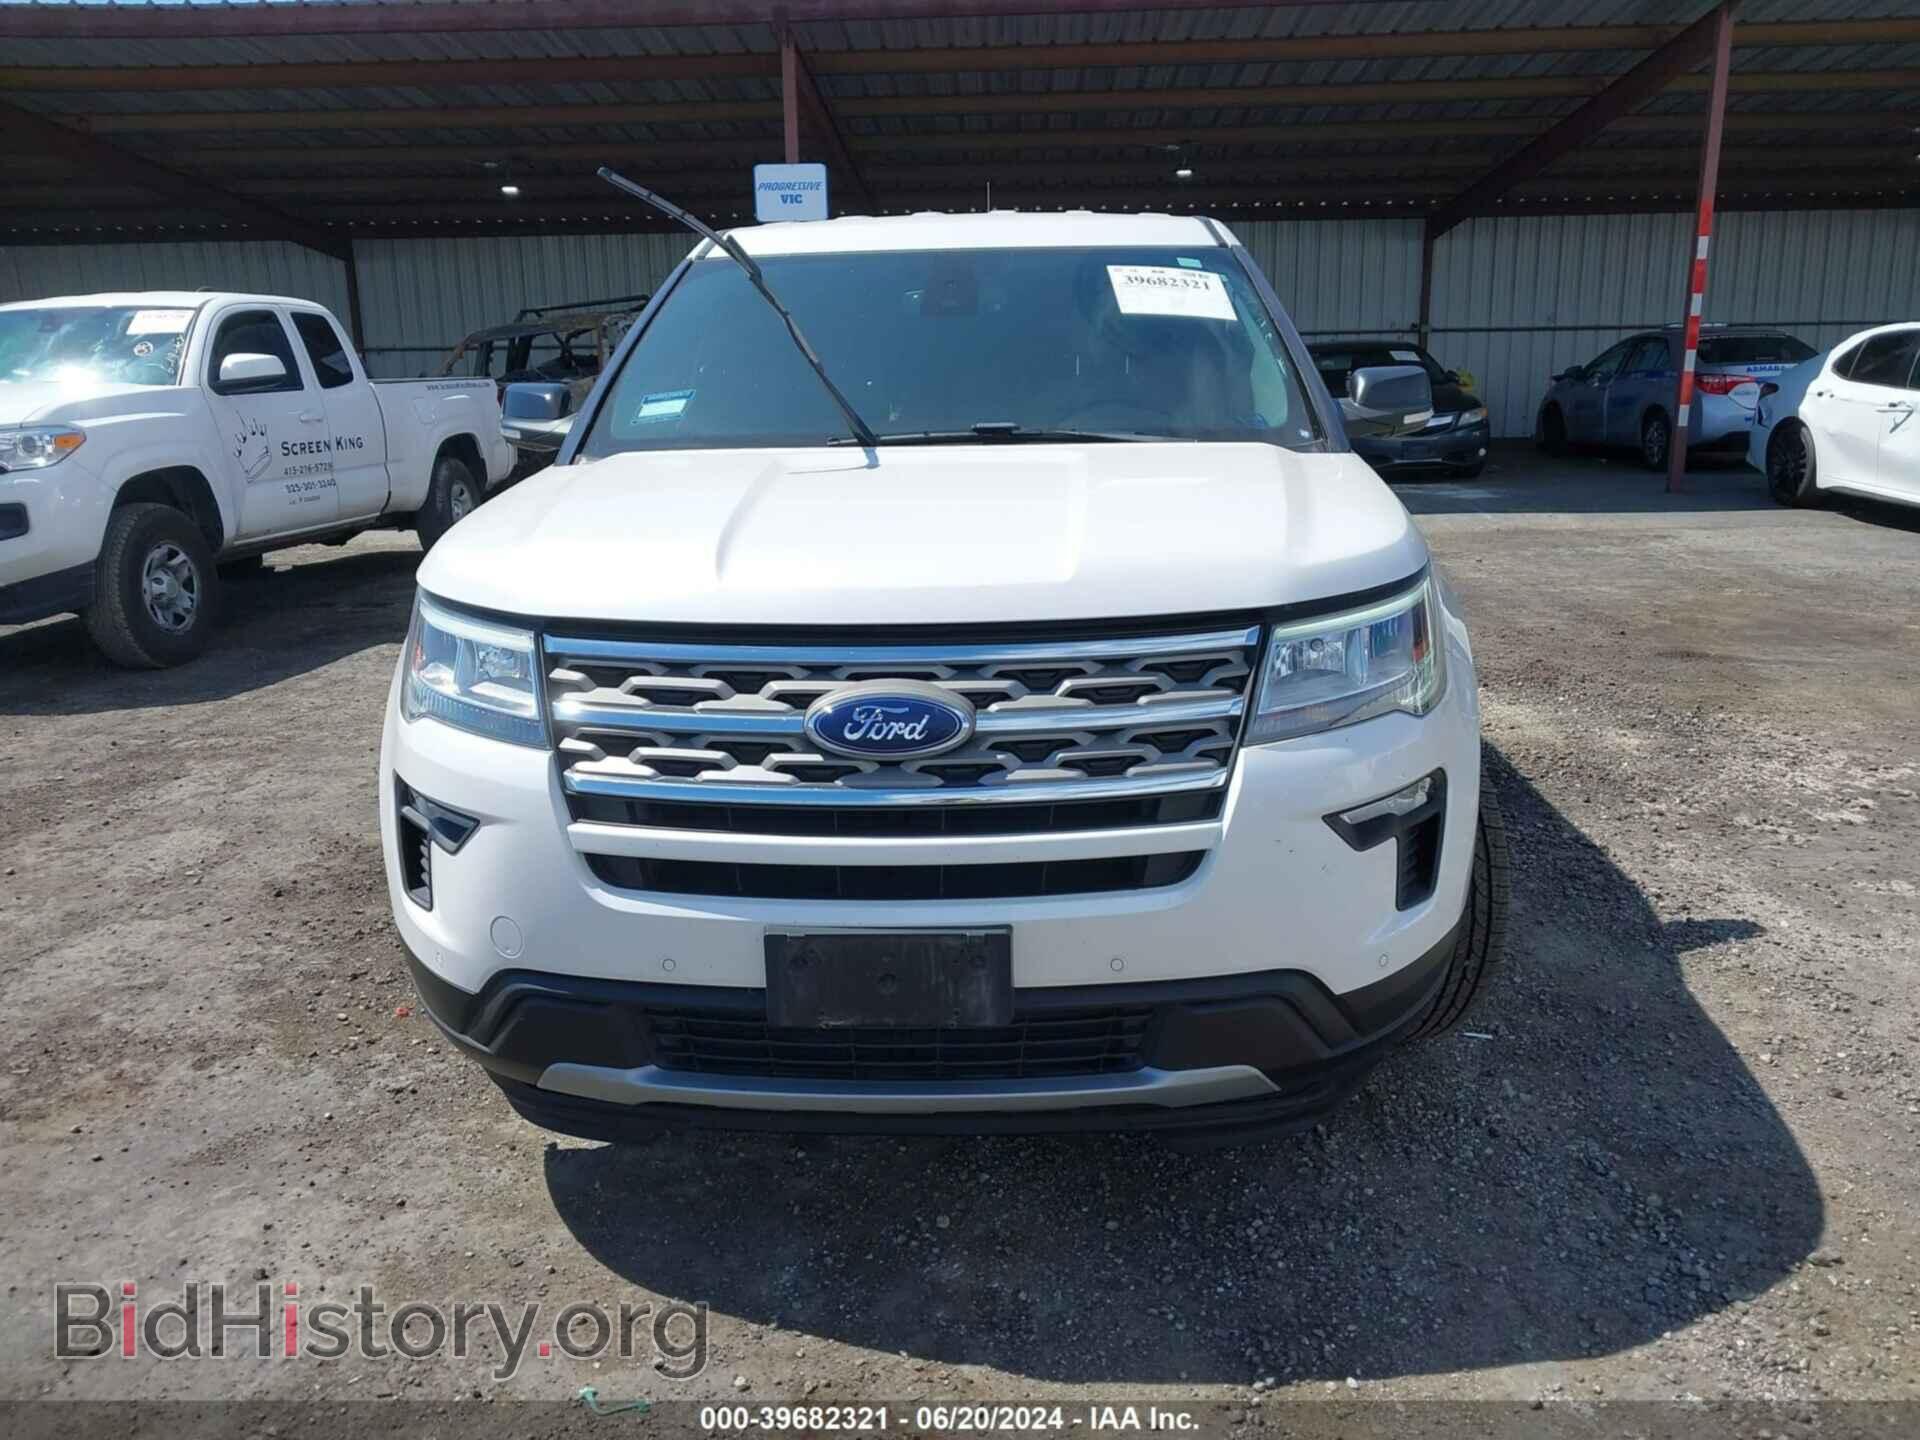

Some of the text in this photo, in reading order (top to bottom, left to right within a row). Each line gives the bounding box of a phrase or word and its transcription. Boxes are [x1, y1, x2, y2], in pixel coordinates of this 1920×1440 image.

[757, 181, 824, 191] PROGRESSIVE
[780, 194, 803, 204] VIC
[1123, 274, 1210, 291] 39682321
[281, 436, 364, 456] SCREEN KING
[843, 705, 930, 741] Ford
